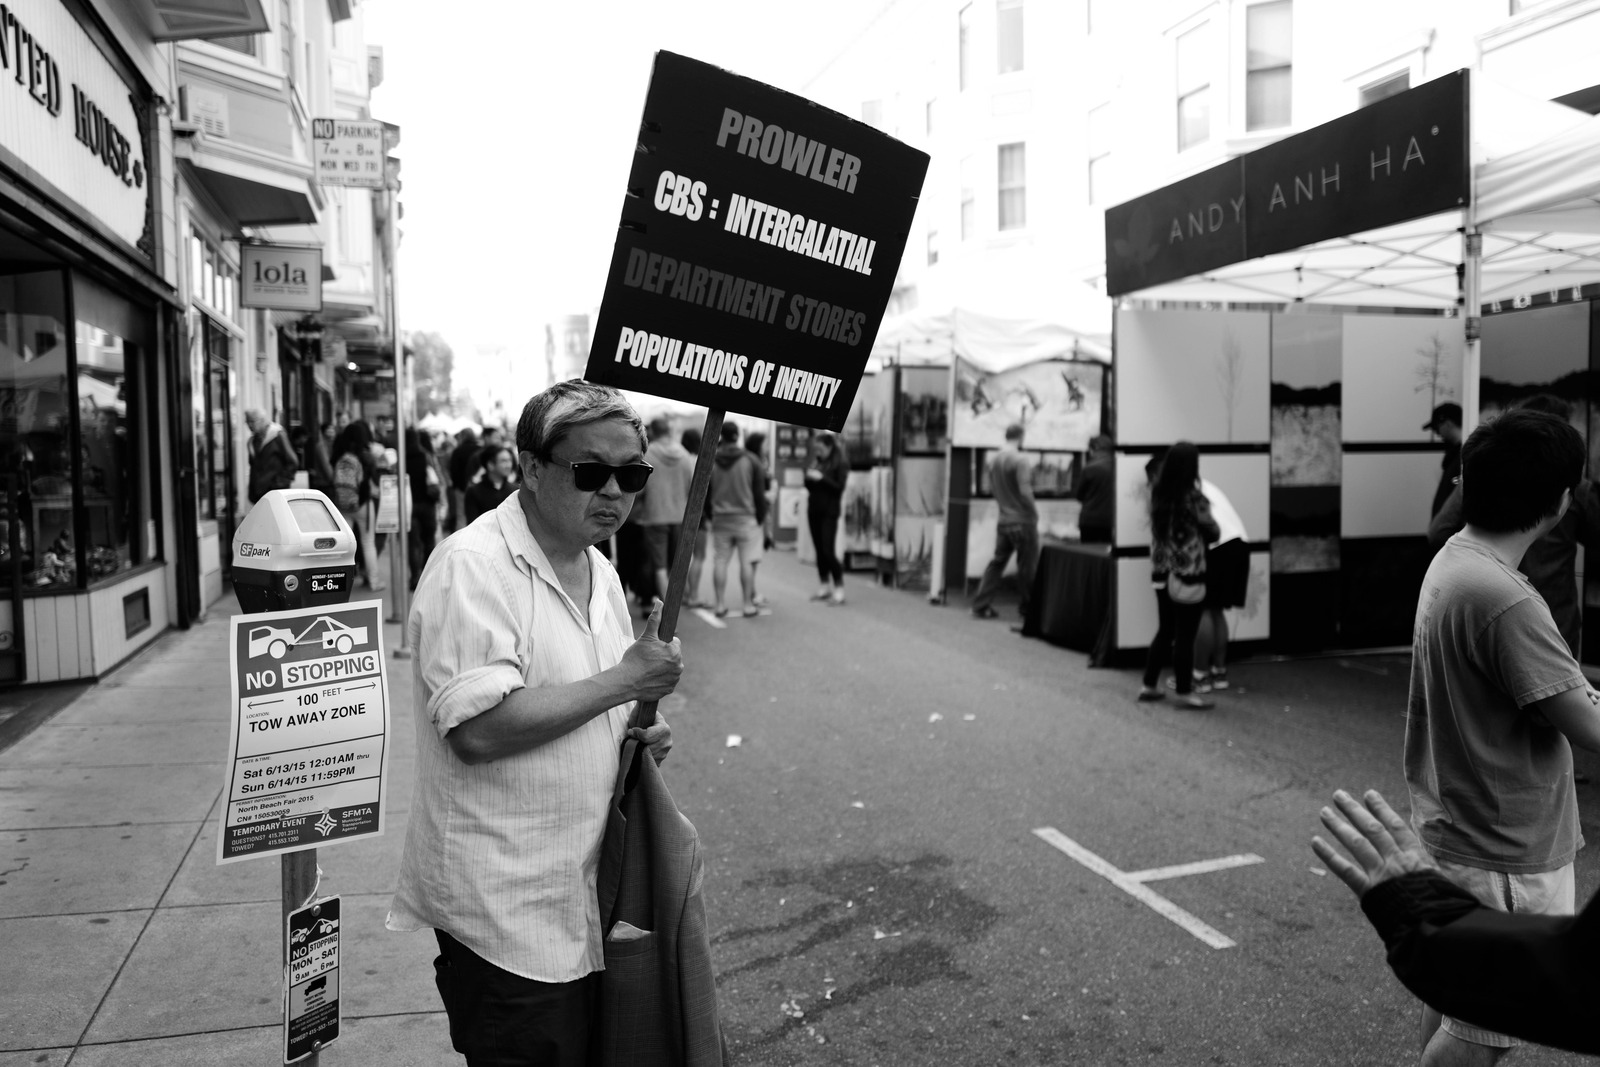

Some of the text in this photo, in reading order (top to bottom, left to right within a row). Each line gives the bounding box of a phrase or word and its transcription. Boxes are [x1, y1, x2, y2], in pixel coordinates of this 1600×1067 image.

[72, 83, 132, 188] HOUSE
[314, 119, 379, 139] NO PARKING
[716, 107, 862, 194] PROWLER
[321, 160, 378, 172] MON WED FRI
[1168, 195, 1246, 245] ANDY
[1268, 162, 1341, 214] ANH
[654, 170, 708, 222] CBS
[724, 192, 877, 276] INTERGALATIAL
[253, 260, 309, 285] lola
[624, 246, 866, 347] DEPARTMENT STORES
[615, 326, 842, 409] POPULATIONS OF INFINITY
[241, 543, 271, 557] SFpark
[246, 655, 375, 691] NO STOPPING
[297, 687, 342, 707] 100 FEET
[249, 703, 366, 733] TOW AWAY ZONE
[243, 753, 370, 780] Sat 6/13/15 12:01AM thru
[241, 766, 356, 794] Sun 6/14/15 11:59PM
[238, 795, 315, 814] North Beach Fair 2015
[254, 808, 291, 820] 150530059
[342, 807, 373, 819] SFMTA
[231, 829, 299, 846] QUESTIONS? 415.701.2311
[232, 817, 307, 837] TEMPORARY EVENT
[231, 843, 255, 852] TOWED?
[292, 934, 338, 960] NO STOPPING
[293, 956, 313, 972] MON
[321, 946, 338, 960] SAT
